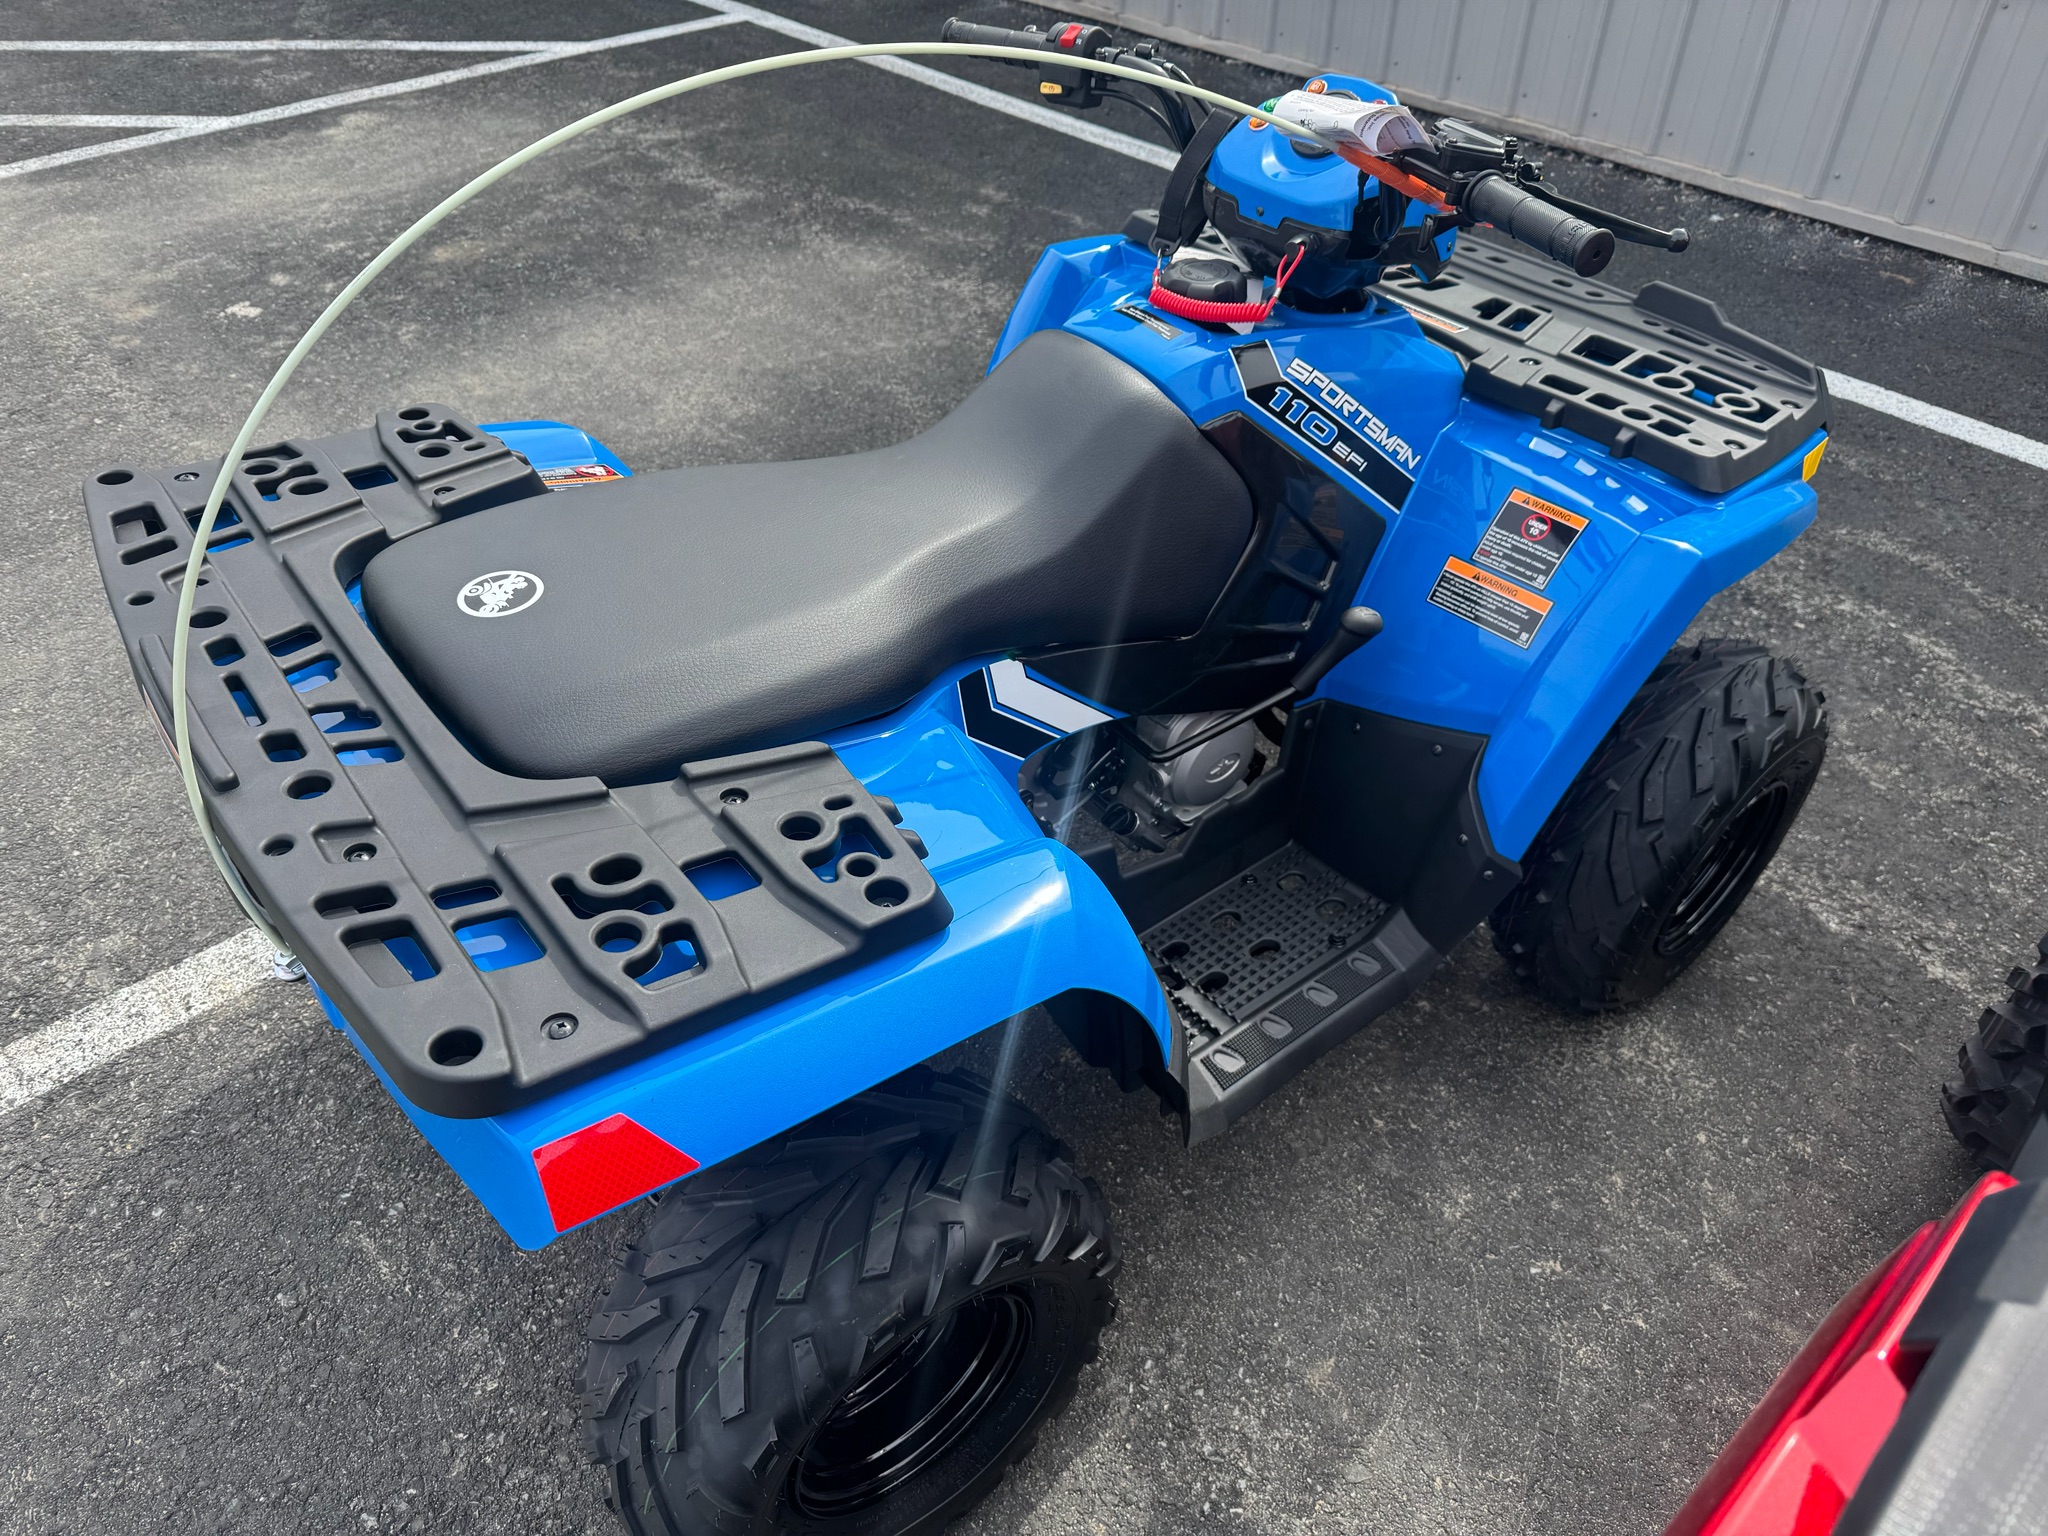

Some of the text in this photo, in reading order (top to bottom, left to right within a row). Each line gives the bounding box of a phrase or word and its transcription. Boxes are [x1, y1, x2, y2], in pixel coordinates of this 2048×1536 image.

[1286, 358, 1422, 470] SPORTSMAN
[1268, 386, 1368, 472] 110 EFI
[1530, 500, 1572, 522] WARNING
[1527, 518, 1548, 531] UNDER
[1528, 526, 1539, 535] 10
[1479, 574, 1518, 597] WARNING
